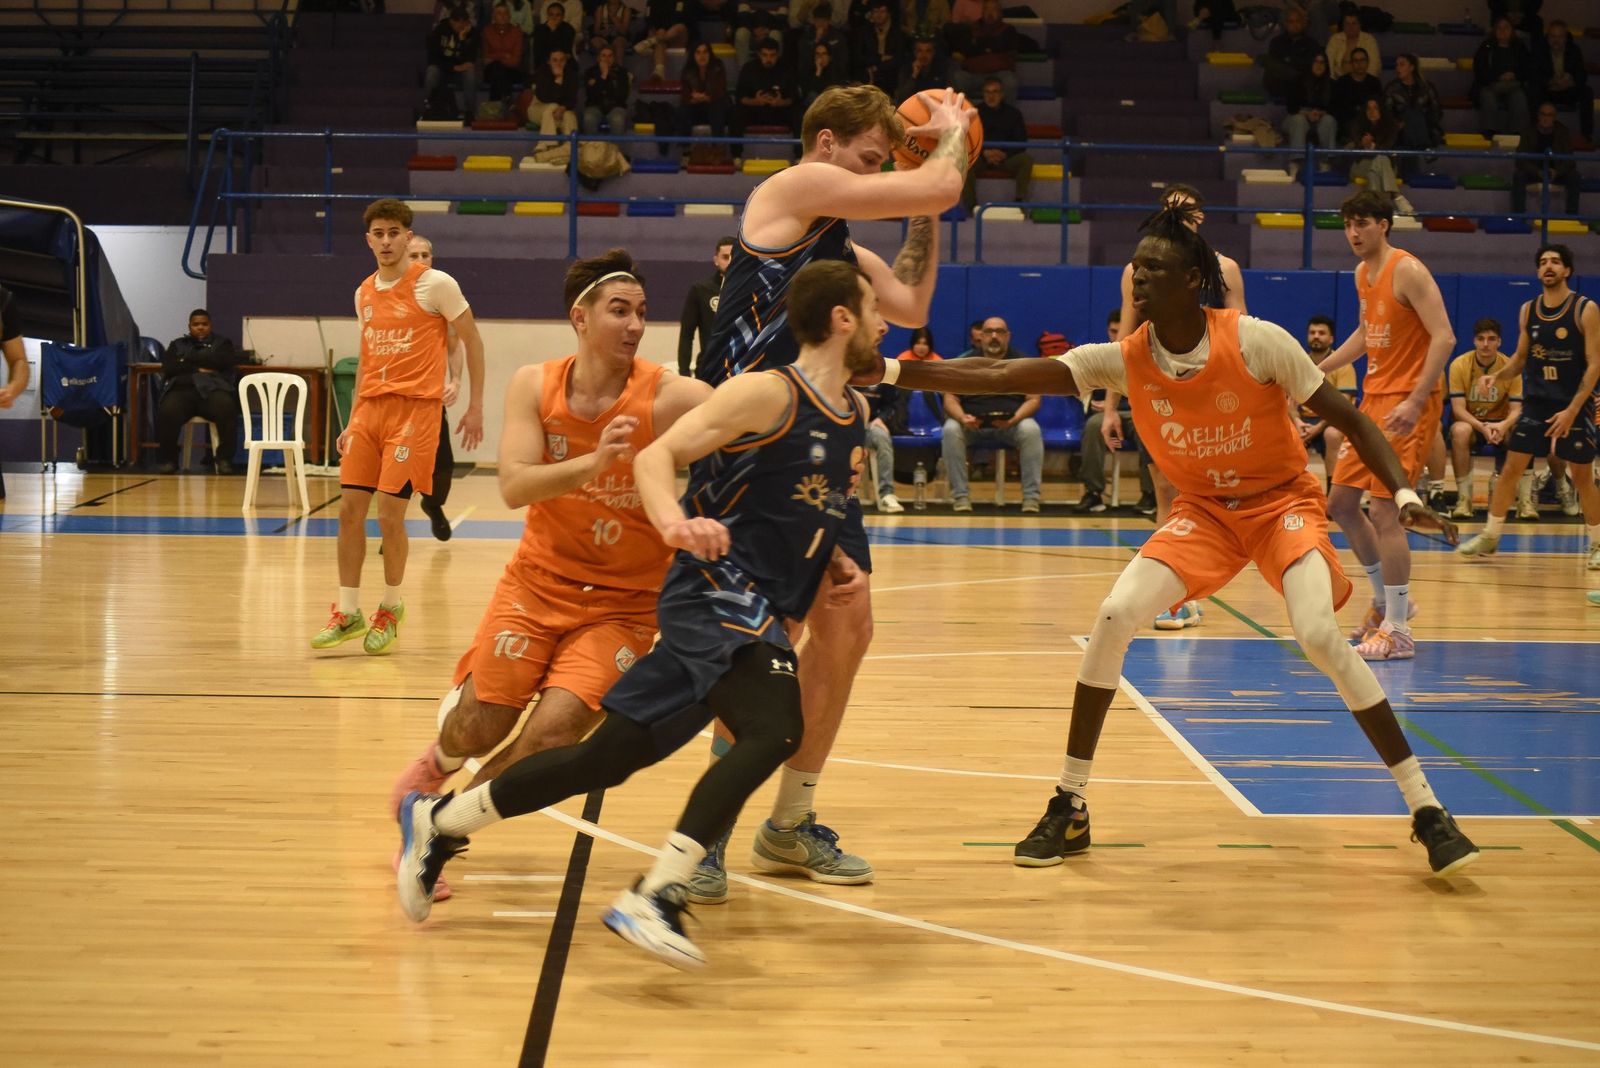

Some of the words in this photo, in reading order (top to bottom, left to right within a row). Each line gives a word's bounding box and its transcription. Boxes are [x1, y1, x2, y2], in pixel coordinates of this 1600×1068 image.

[1542, 365, 1559, 380] 10
[1197, 433, 1254, 459] DEPORTE
[591, 518, 623, 546] 10
[494, 629, 530, 661] 10
